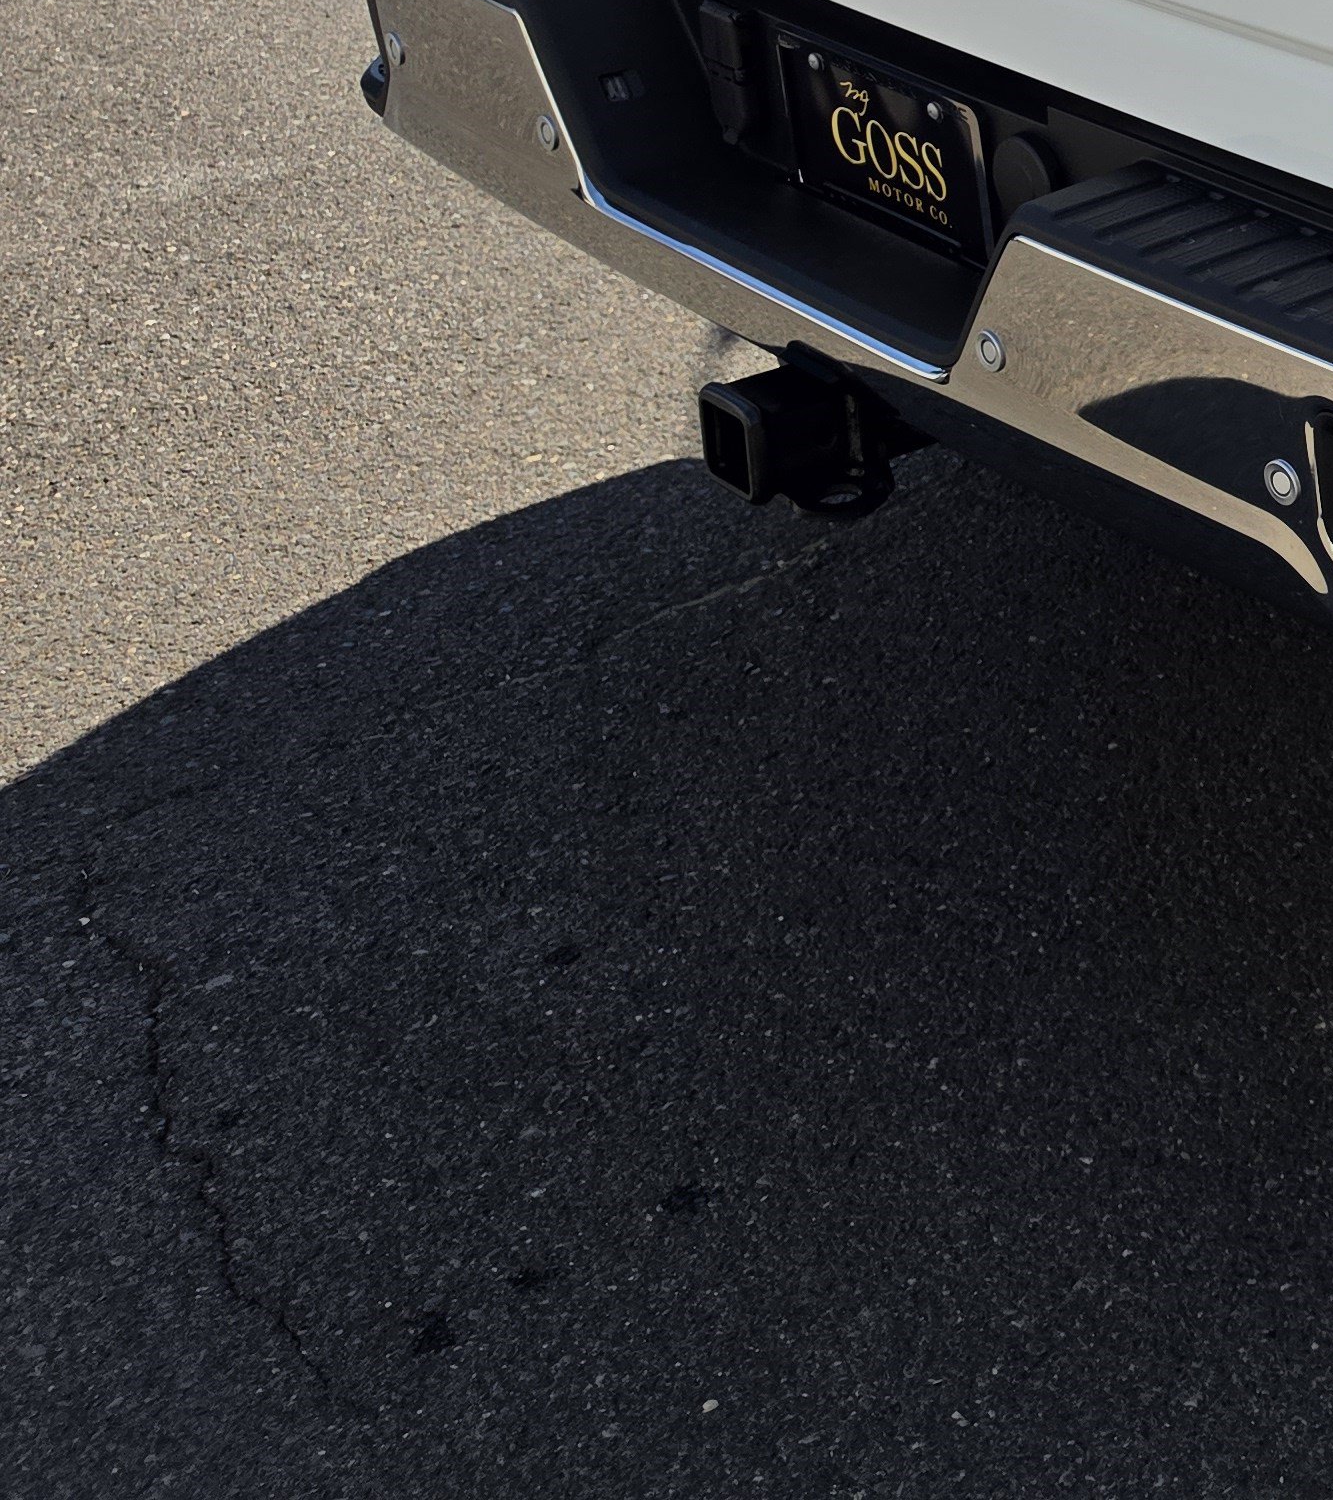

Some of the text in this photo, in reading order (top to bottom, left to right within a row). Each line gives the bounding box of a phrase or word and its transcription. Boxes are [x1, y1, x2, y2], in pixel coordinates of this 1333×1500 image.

[831, 106, 947, 201] GOSS
[868, 176, 953, 229] MOTOR CO.
